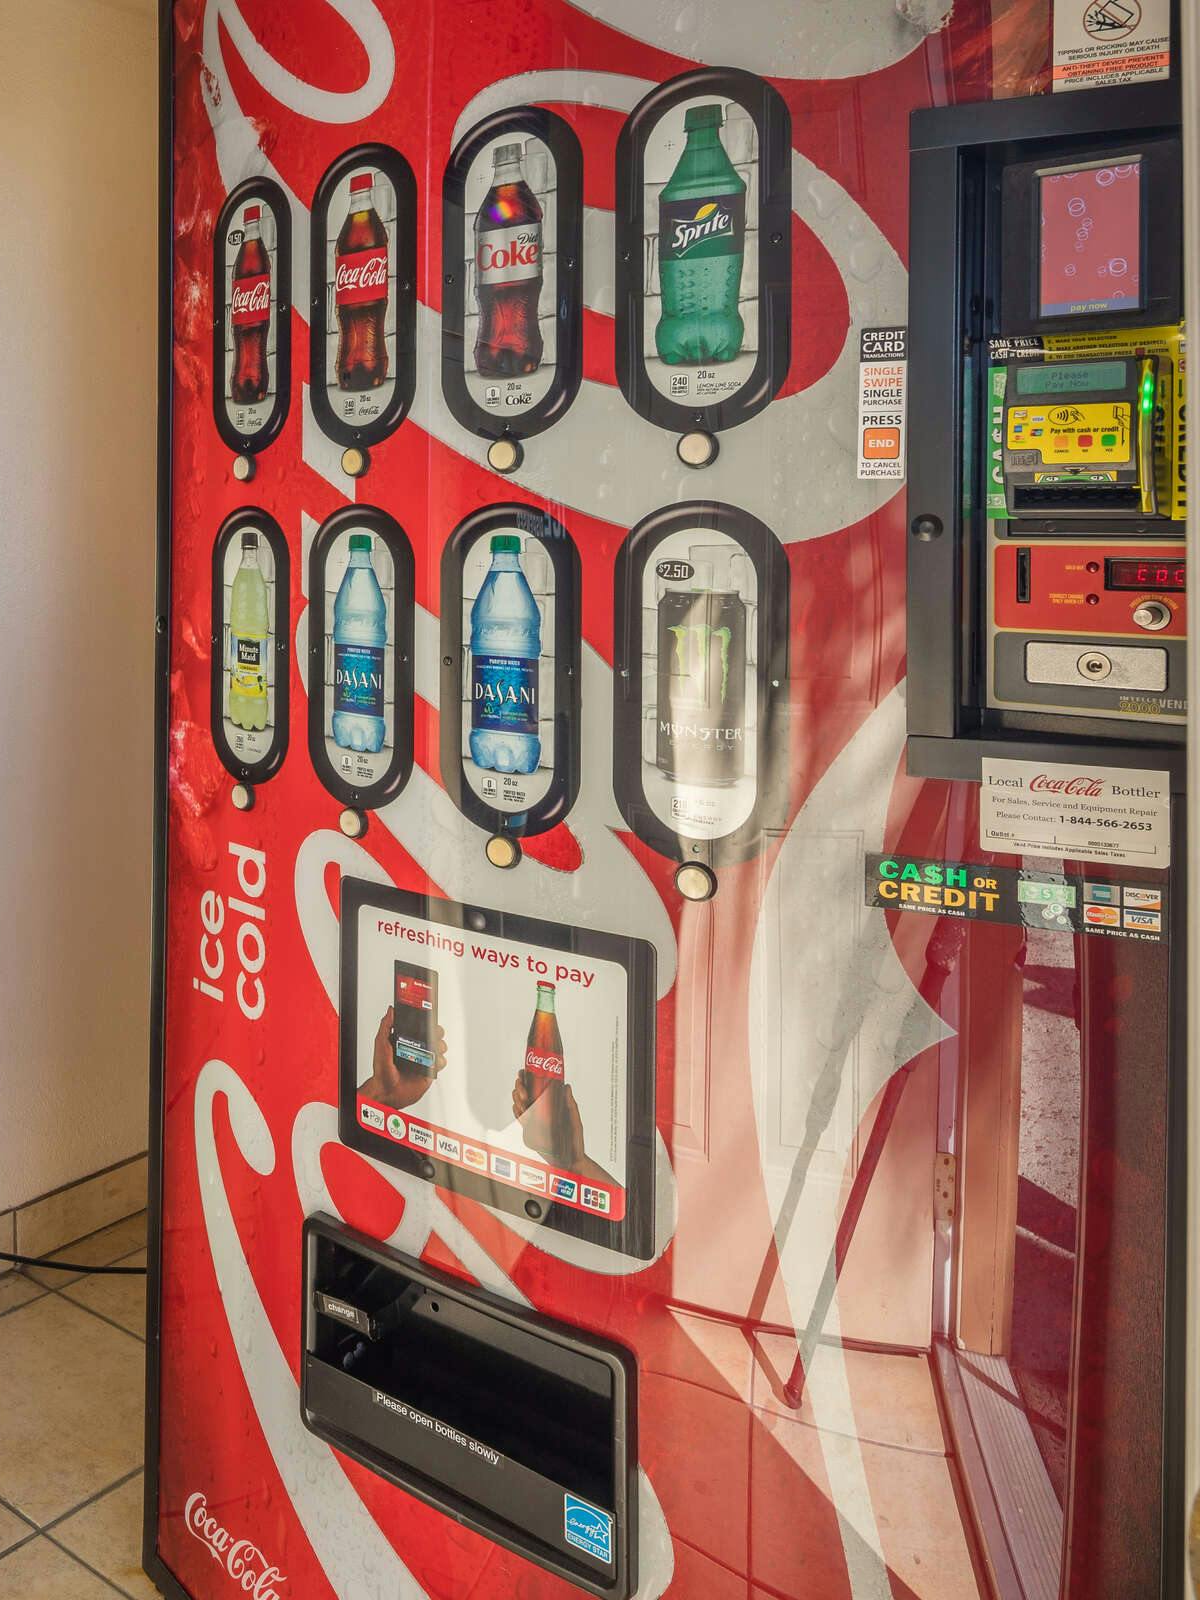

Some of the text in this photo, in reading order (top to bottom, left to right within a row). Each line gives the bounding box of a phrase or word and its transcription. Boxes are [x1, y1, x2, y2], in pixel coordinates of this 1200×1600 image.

[1057, 48, 1083, 56] TIPPING
[1096, 42, 1128, 51] ROCKING
[1145, 37, 1169, 45] CAUSE
[1068, 53, 1098, 61] SERIOUS
[1099, 49, 1123, 57] INJURY
[1136, 44, 1160, 52] DEATH
[1102, 58, 1127, 67] DEVICE
[1128, 54, 1165, 63] PREVENTS
[1125, 61, 1158, 70] PRODUCT
[1064, 77, 1083, 85] PRICE
[1121, 67, 1164, 77] APPLICABLE
[671, 211, 729, 249] Sprite
[477, 240, 539, 271] Coke
[336, 255, 388, 292] Coca-Cola
[232, 281, 270, 314] Coca-Cola
[1071, 302, 1108, 312] pay now
[862, 330, 906, 341] CREDIT
[862, 341, 905, 353] CARD
[988, 337, 1039, 349] SAME PRICE
[697, 370, 707, 379] 20
[864, 366, 903, 376] SINGLE
[1051, 371, 1089, 381] Please
[672, 376, 688, 386] 240
[864, 377, 903, 388] SWIPE
[863, 388, 903, 398] SINGLE
[505, 395, 532, 406] Coke
[862, 415, 902, 425] PRESS
[1050, 428, 1061, 436] Pay
[868, 439, 895, 448] END
[658, 564, 689, 579] $2.50
[239, 643, 259, 653] Minute
[241, 652, 256, 662] Maid
[336, 664, 382, 690] DASANI
[475, 679, 535, 705] DASANI
[1120, 701, 1160, 714] 2000
[660, 720, 743, 742] MONSTER
[503, 777, 511, 786] 20
[988, 774, 1161, 799] Local Coca-Cola Bottler
[1007, 796, 1030, 806] Sales,
[1032, 799, 1061, 809] Service
[1063, 802, 1079, 810] and
[1080, 803, 1127, 816] Equipment
[1129, 807, 1158, 818] Repair
[996, 811, 1153, 832] Please Contact: 1-844-566-2653
[973, 877, 998, 890] OR
[878, 880, 1000, 912] CREDIT
[1125, 891, 1159, 900] DISCOVER
[947, 909, 965, 917] CASH
[1131, 915, 1153, 925] VISA
[228, 841, 267, 1021] cold
[1085, 927, 1160, 941] SAME PRICE AS CASH
[193, 889, 225, 1003] ice
[377, 919, 595, 988] refreshing ways to pay
[526, 1051, 562, 1075] Coca-Cola
[370, 1110, 384, 1127] Pay
[414, 1134, 428, 1145] pay
[439, 1140, 458, 1155] VISA
[328, 1303, 355, 1318] change
[376, 1392, 500, 1465] Please open bottles slowly
[567, 1533, 609, 1559] ENERGY STAR
